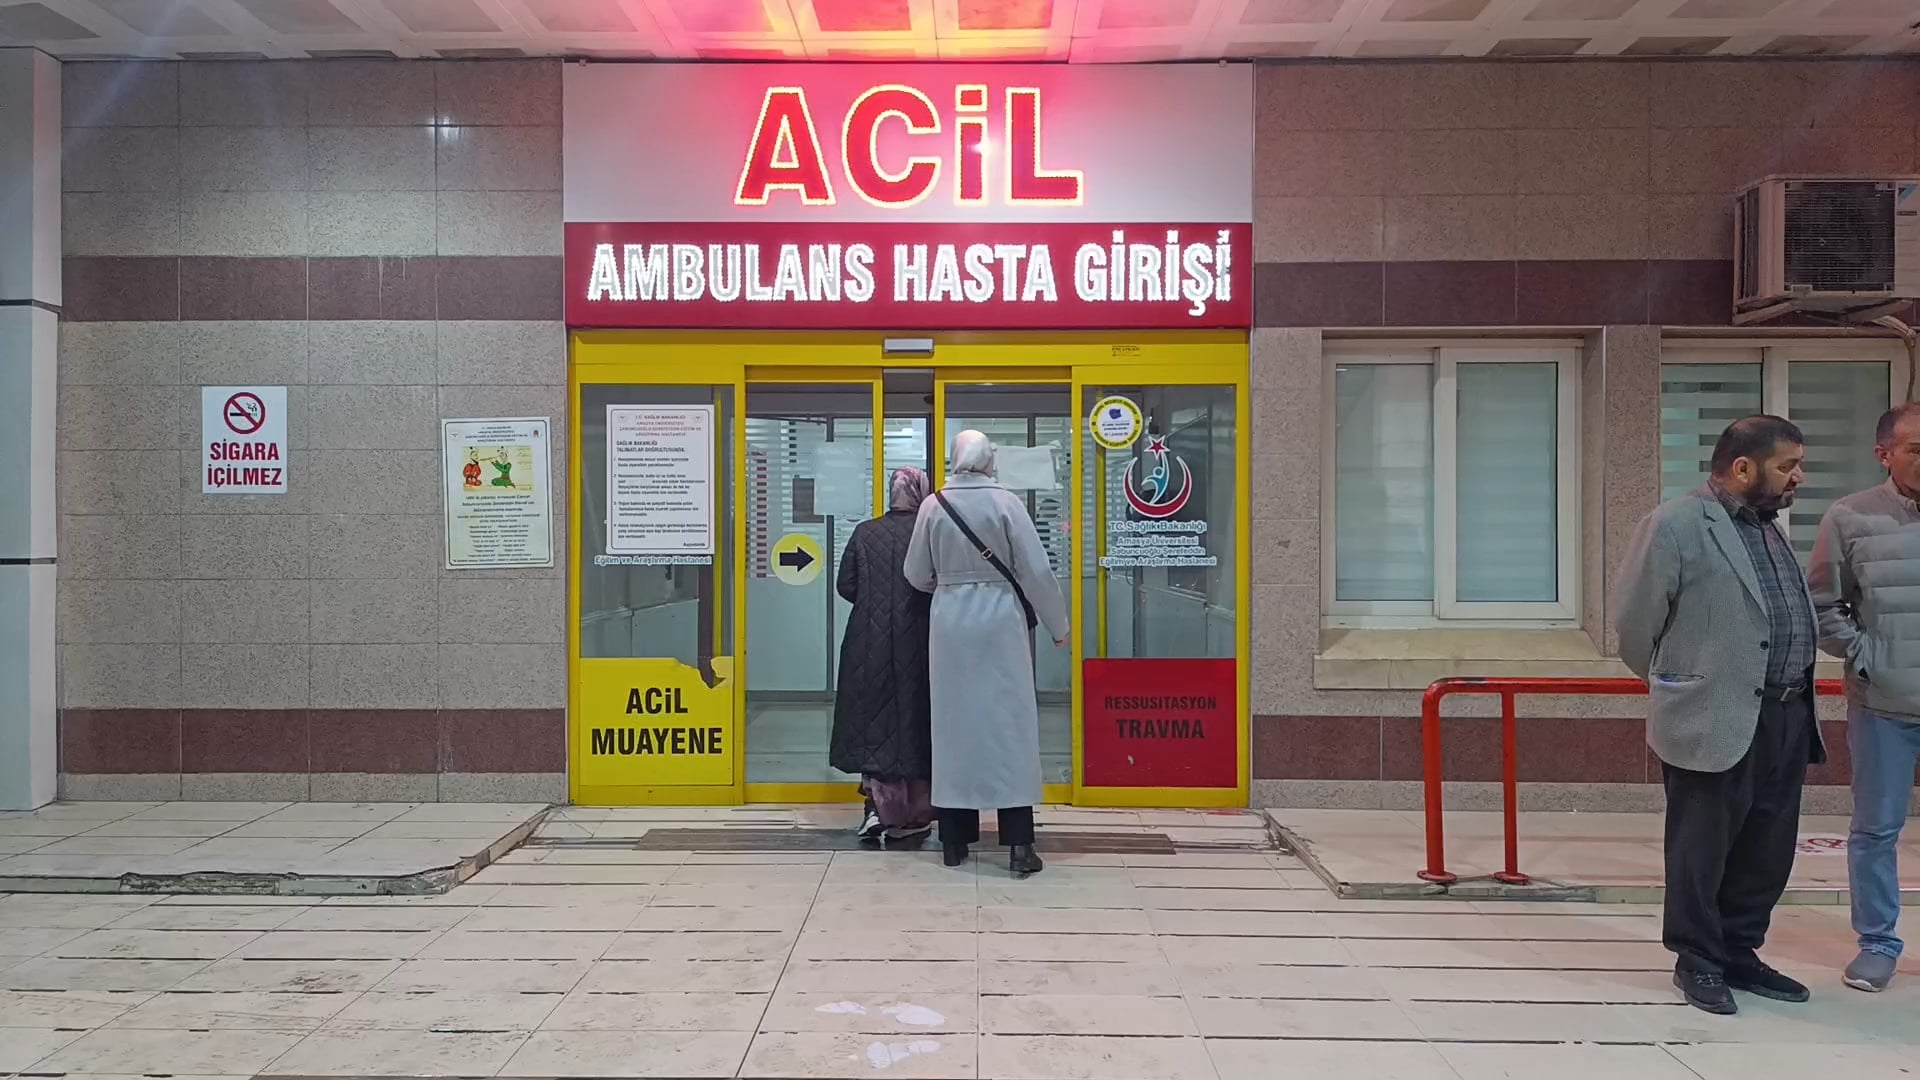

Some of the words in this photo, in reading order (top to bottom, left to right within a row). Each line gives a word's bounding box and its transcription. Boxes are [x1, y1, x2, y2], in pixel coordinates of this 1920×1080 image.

[587, 243, 875, 302] AMBULANS
[893, 243, 1058, 302] HASTA
[1074, 230, 1232, 317] GİRİŞİ
[209, 439, 280, 461] SİGARA
[207, 464, 282, 488] İÇİLMEZ
[1127, 520, 1158, 533] Sağlık
[1159, 520, 1207, 533] Bakanlığı
[1104, 695, 1217, 710] RESSUSITASYON
[1116, 719, 1206, 739] TRAVMA
[591, 727, 723, 756] MUAYENE
